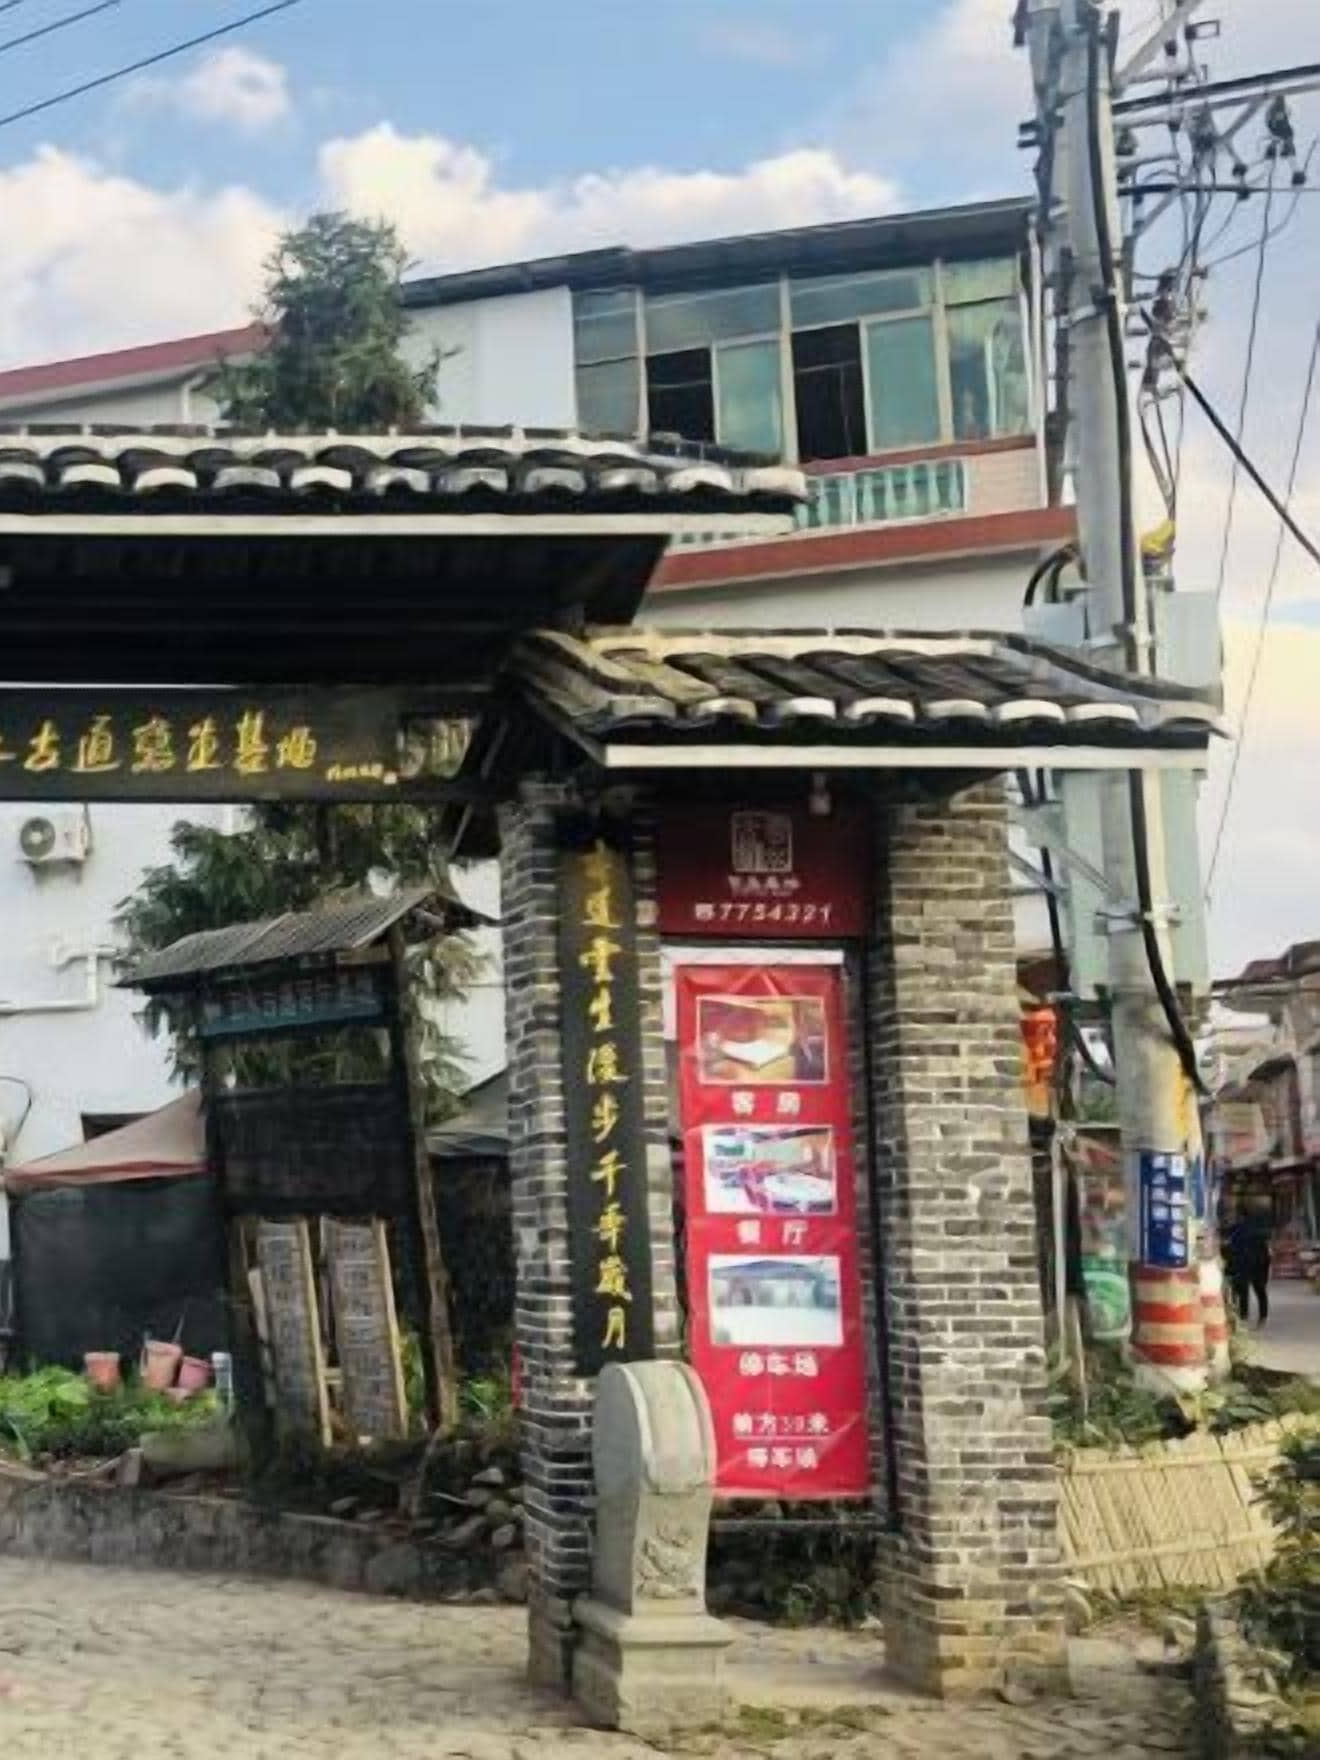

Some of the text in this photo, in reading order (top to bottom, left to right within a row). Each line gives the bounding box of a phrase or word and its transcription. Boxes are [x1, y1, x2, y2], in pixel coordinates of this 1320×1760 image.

[737, 1220, 809, 1245] 餐厅
[739, 1352, 819, 1377] 停车场
[747, 1446, 818, 1469] 停车场
